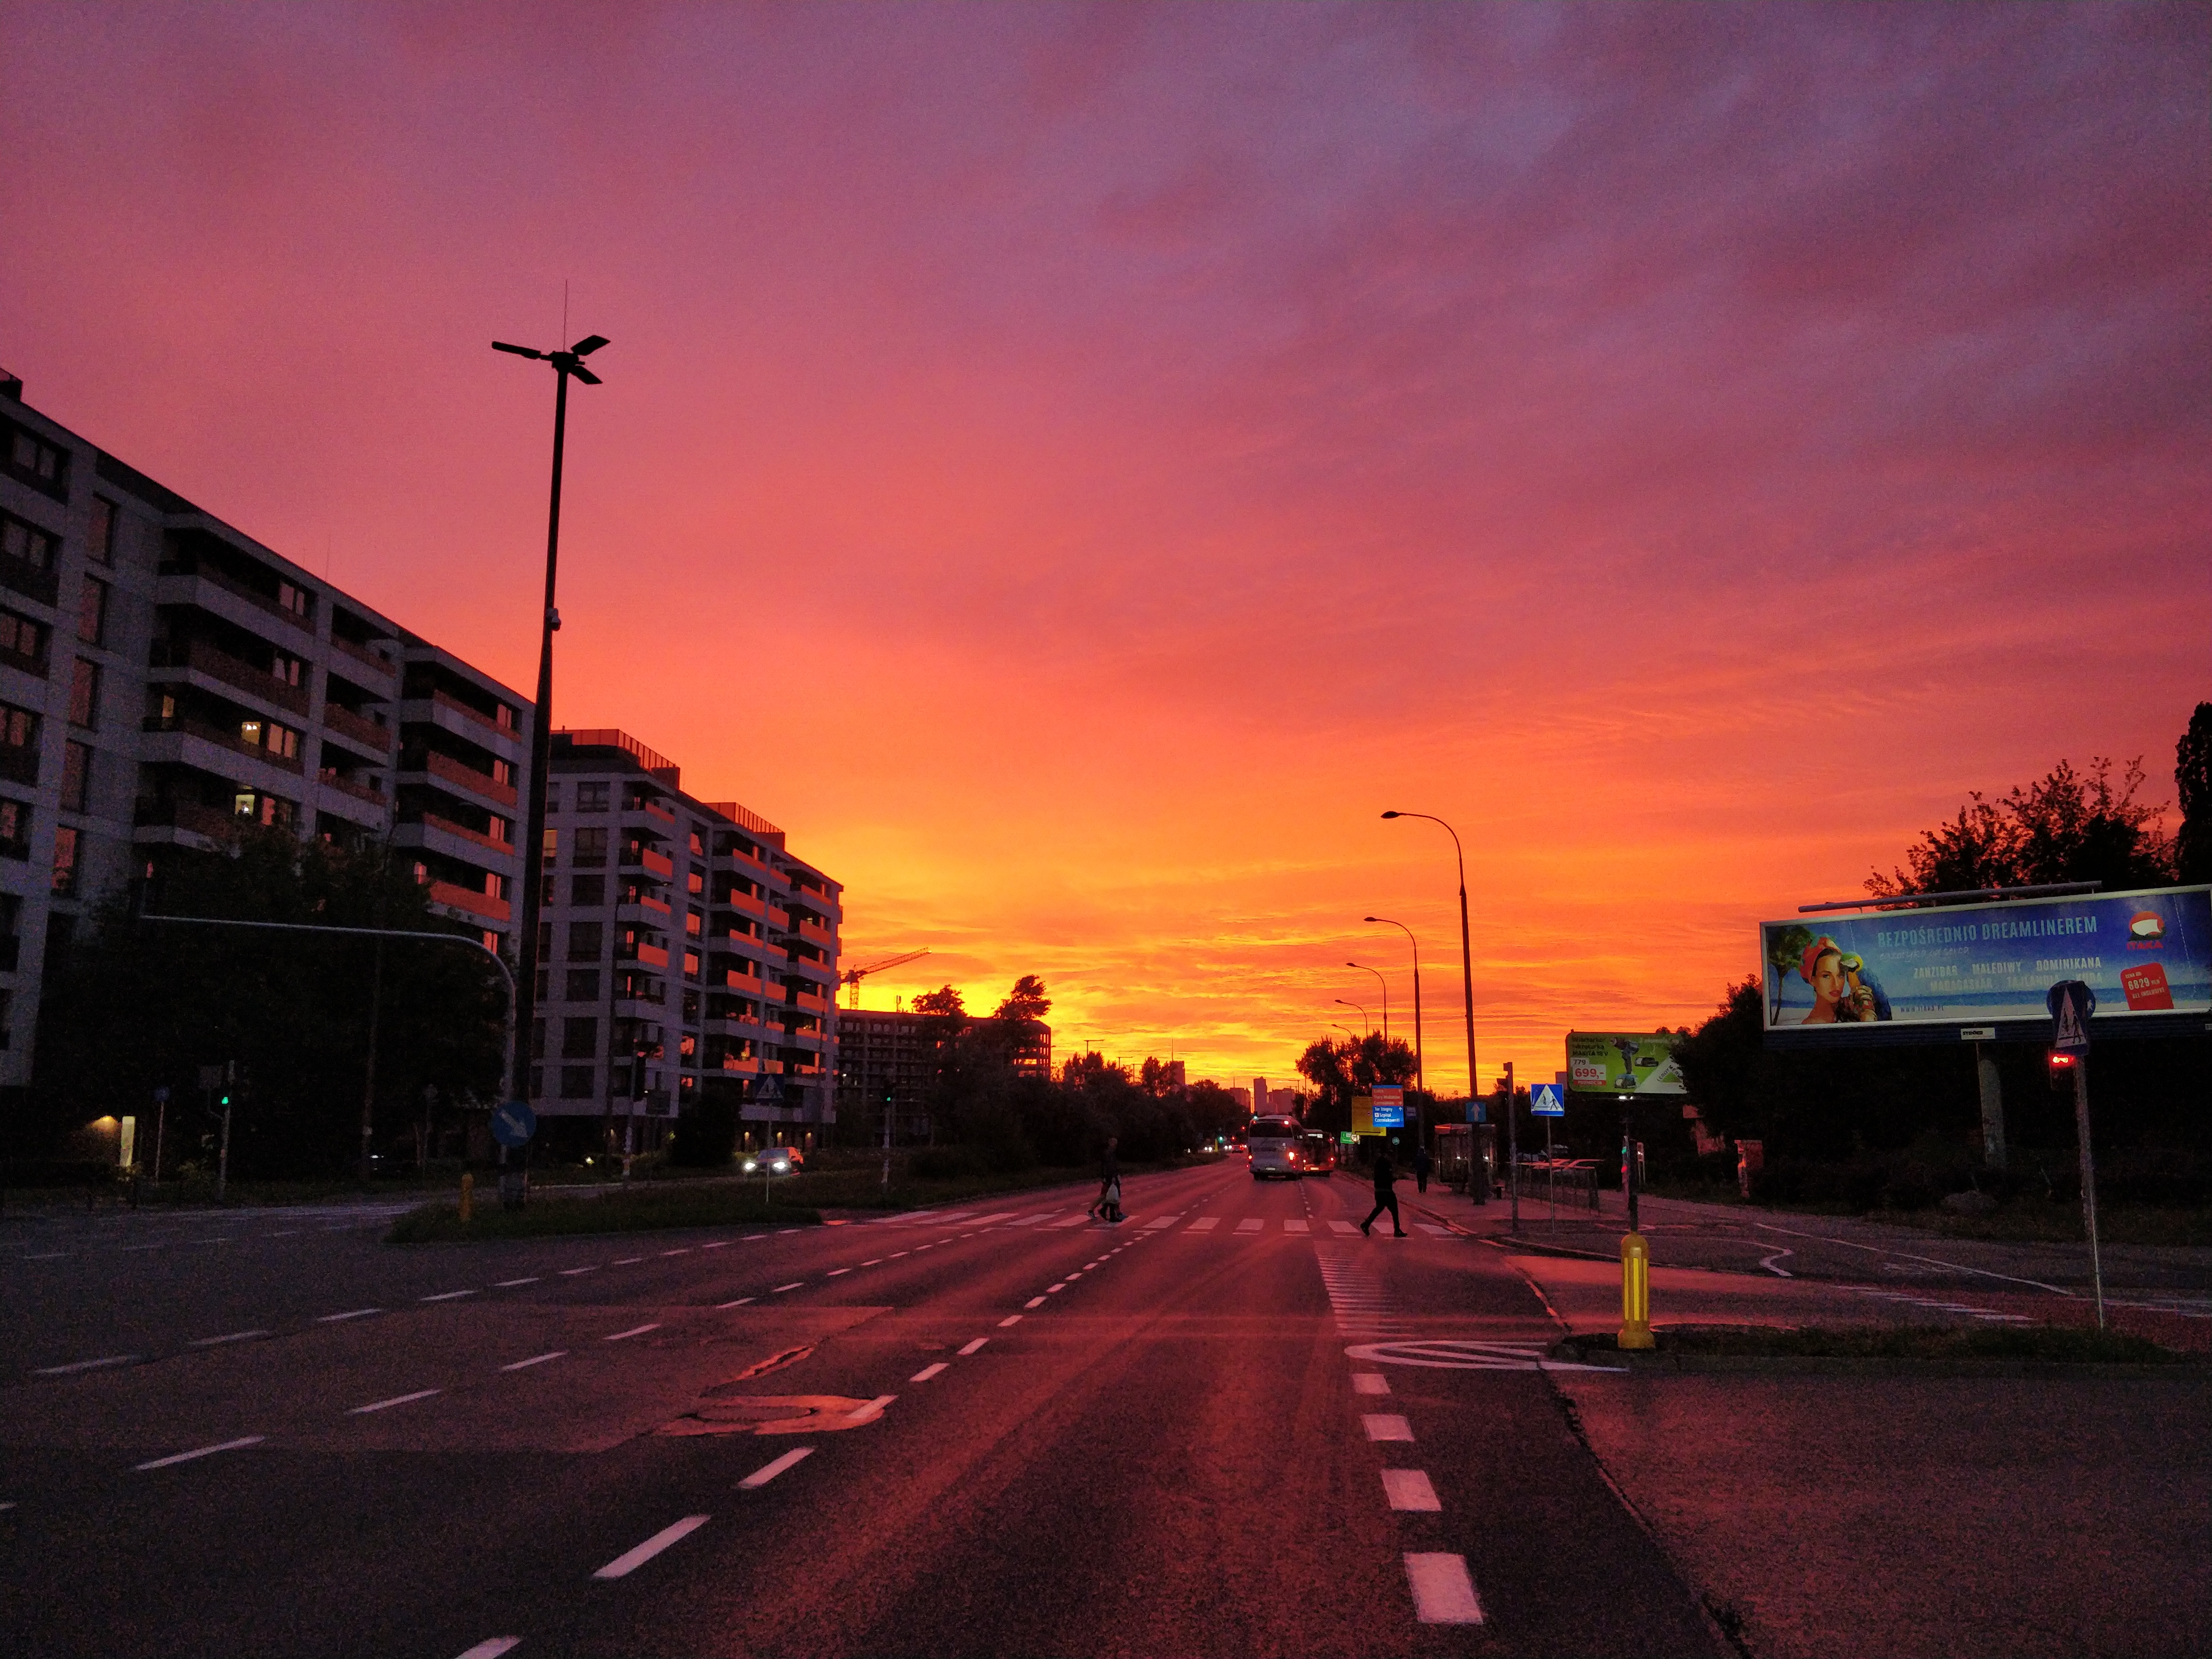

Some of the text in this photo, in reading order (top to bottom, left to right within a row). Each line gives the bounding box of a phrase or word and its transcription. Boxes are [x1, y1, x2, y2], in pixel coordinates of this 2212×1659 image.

[1877, 916, 2097, 947] BEZPOŚREDNIO DREAMLINEREM
[2126, 940, 2164, 950] ITAKA
[1914, 956, 2102, 978] ZANZIBAR MALEDIWY DOMINIKANA
[1930, 978, 1992, 992] MADAGASKAR
[2128, 977, 2150, 990] 6829
[1575, 1068, 1604, 1079] 699,-
[1657, 1068, 1670, 1082] LEROY
